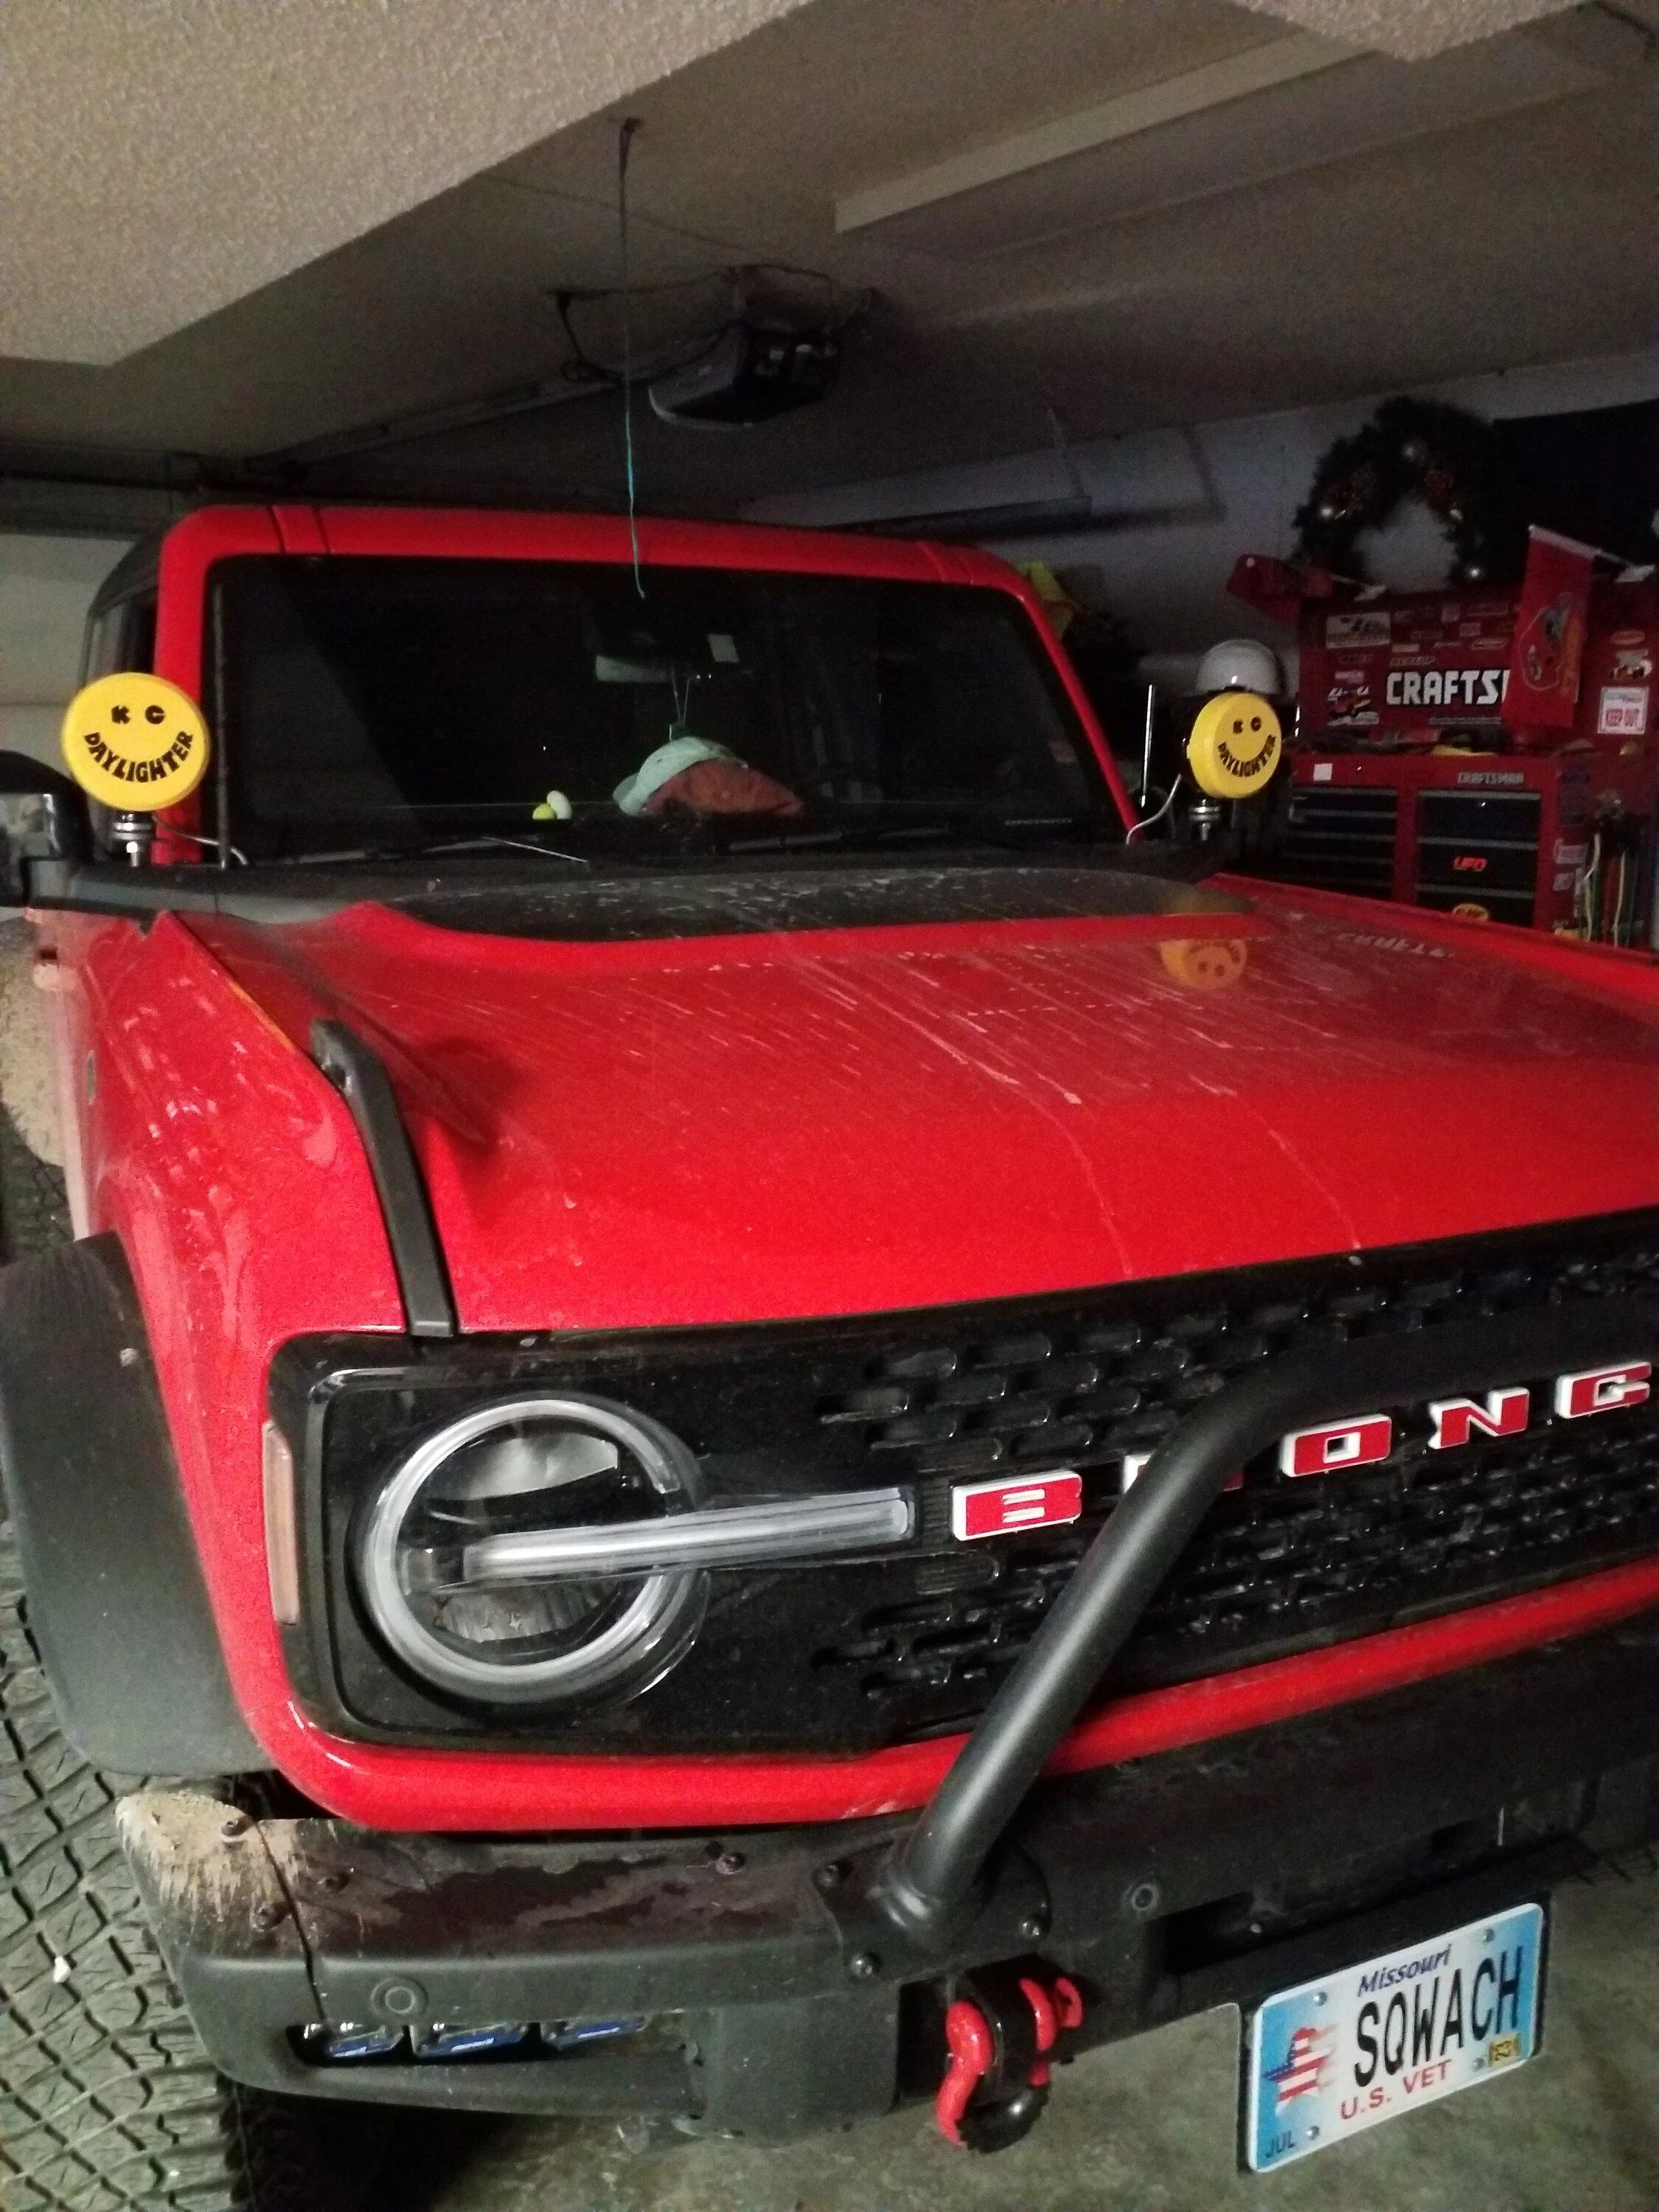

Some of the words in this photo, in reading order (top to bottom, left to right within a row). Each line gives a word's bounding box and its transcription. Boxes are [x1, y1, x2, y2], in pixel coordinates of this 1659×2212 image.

[84, 731, 194, 783] DAYLIGHTER
[1357, 1944, 1453, 1997] Missouri
[1354, 1945, 1523, 2087] SQWACH
[1340, 2086, 1392, 2121] U.S.
[1402, 2059, 1453, 2095] VET
[1265, 2129, 1295, 2159] JUL
